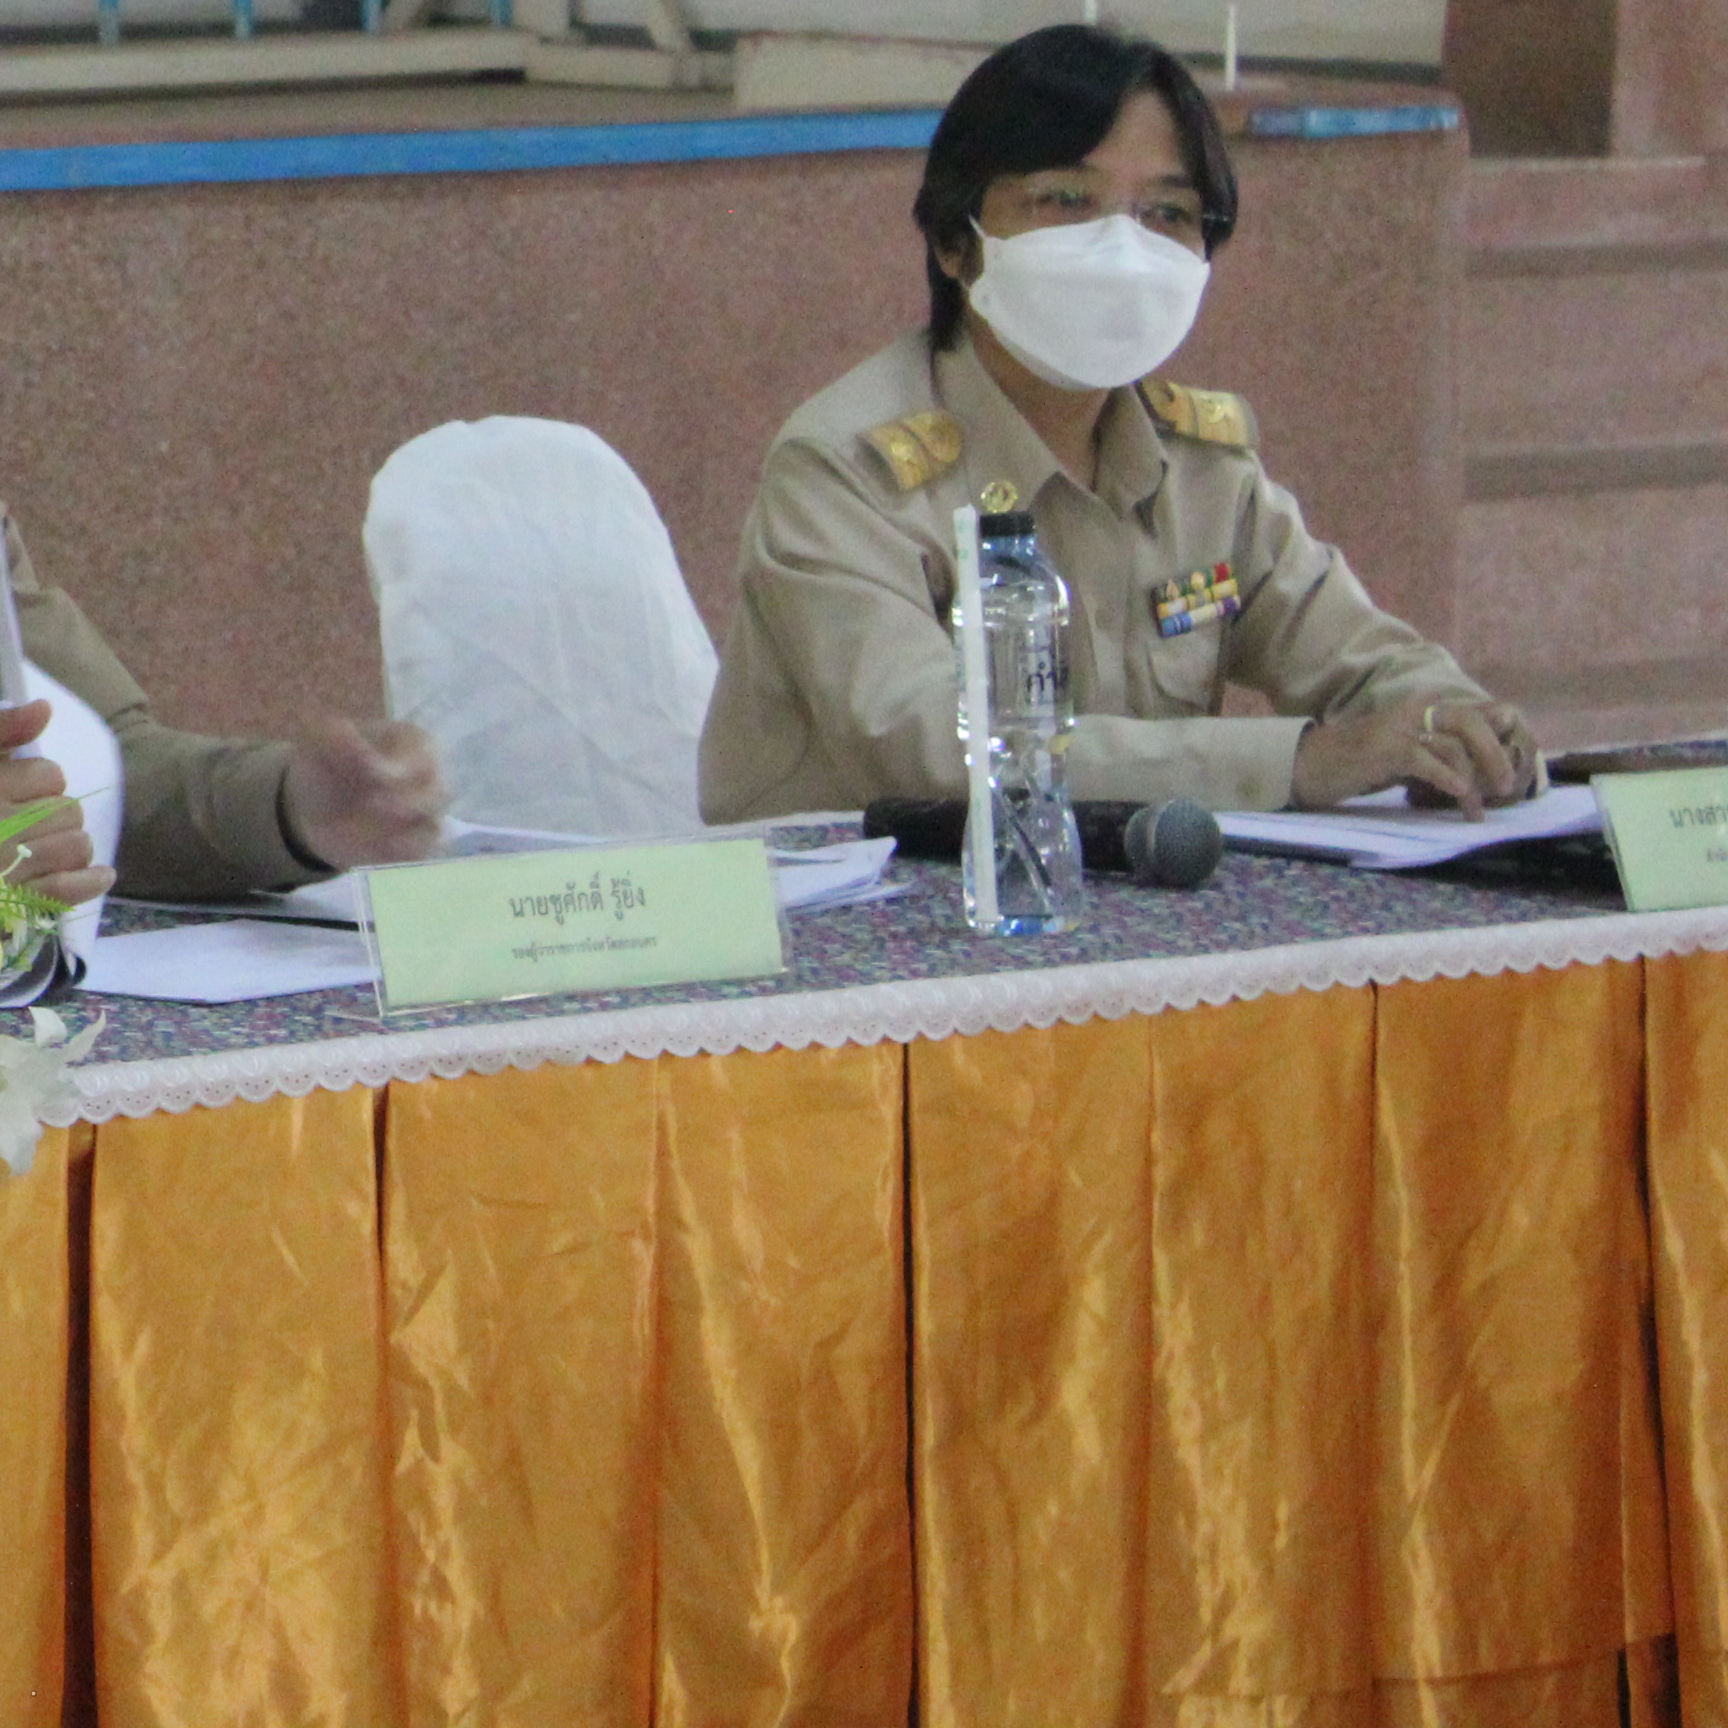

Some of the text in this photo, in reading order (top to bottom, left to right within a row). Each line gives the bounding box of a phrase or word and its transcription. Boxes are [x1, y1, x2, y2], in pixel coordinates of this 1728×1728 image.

[509, 871, 604, 925] นายชูศักดิ์
